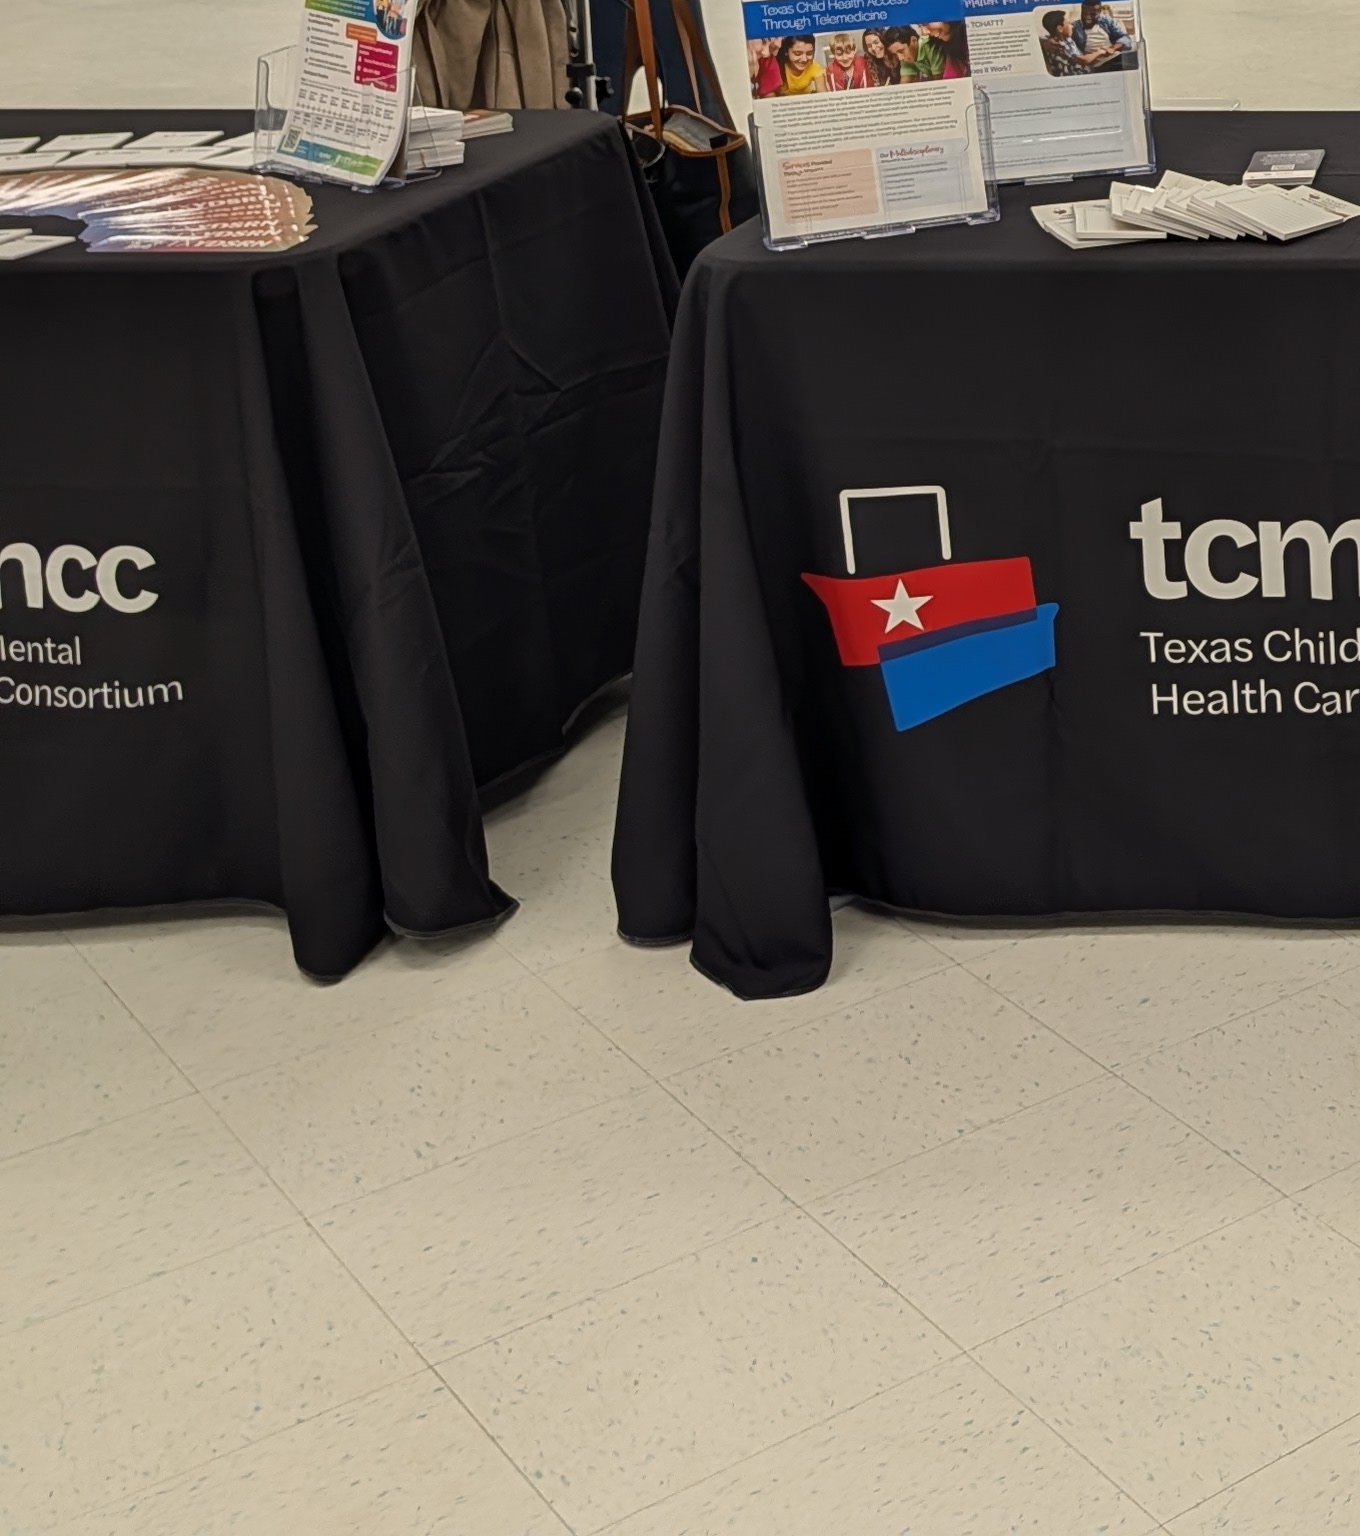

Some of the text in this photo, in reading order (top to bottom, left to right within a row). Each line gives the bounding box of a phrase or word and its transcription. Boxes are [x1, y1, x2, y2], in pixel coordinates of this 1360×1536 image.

[761, 3, 795, 16] Texas
[796, 0, 825, 14] Child
[762, 10, 888, 31] Through Telemedicine
[1140, 632, 1253, 663] Texas
[1152, 679, 1282, 715] Health
